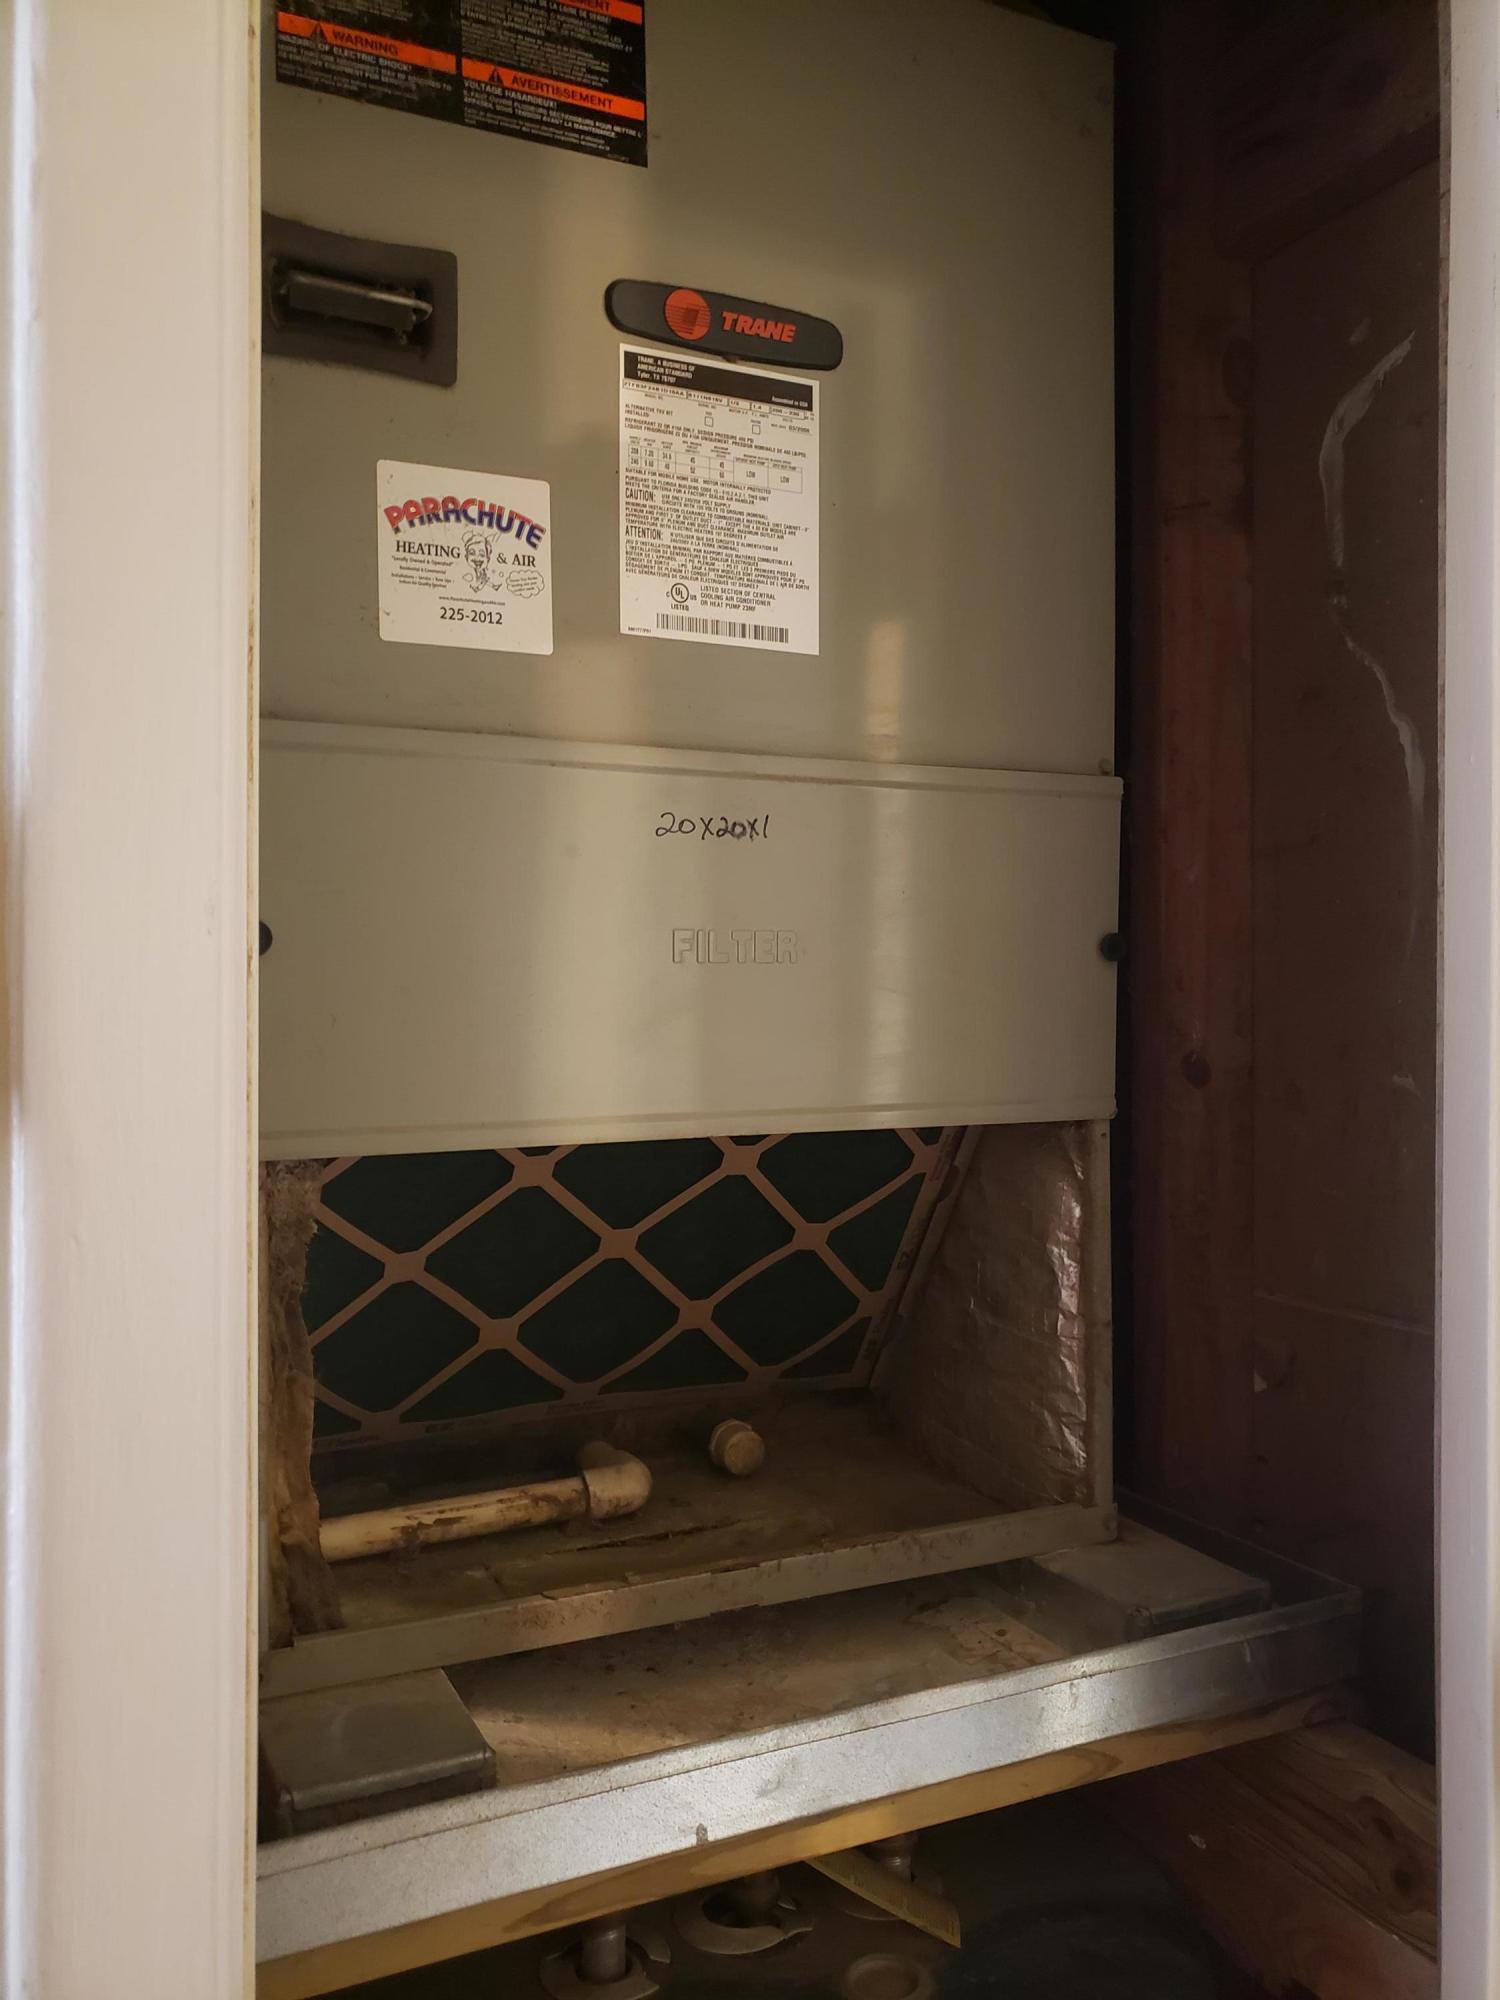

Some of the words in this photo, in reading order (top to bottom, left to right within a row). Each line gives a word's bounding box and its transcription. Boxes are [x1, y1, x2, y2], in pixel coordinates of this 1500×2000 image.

[332, 28, 397, 55] WARNING
[319, 42, 330, 52] OF
[333, 46, 376, 64] ELECTRIC
[464, 79, 502, 95] VOLTAGE
[511, 75, 613, 109] AVERTISSEMENT
[721, 312, 797, 342] TRANE
[637, 362, 663, 373] AMERICAN
[665, 368, 692, 378] STANDARD
[662, 359, 687, 370] BUSINESS
[688, 364, 696, 372] OF
[625, 416, 655, 426] REFRIGERANT
[714, 432, 736, 440] PRESSURE
[625, 467, 645, 475] SUITABLE
[719, 482, 745, 490] INTERNALLY
[747, 486, 771, 494] PROTECTED
[625, 475, 649, 483] PURSUANT
[678, 483, 698, 491] BUILDING
[746, 470, 755, 478] LOW
[780, 475, 789, 483] LOW
[625, 487, 655, 502] CAUTION:
[651, 484, 671, 492] CRITERIA
[734, 497, 754, 505] HANDLER
[661, 499, 681, 507] CIRCUITS
[625, 500, 647, 508] MINIMUM
[648, 504, 679, 513] INSTALLATION
[680, 509, 705, 517] CLEARANCE
[384, 496, 547, 550] PARACHUTE
[625, 518, 657, 527] TEMPERATURE
[625, 512, 649, 520] APPROVED
[737, 528, 758, 536] MAXIMUM
[625, 524, 663, 541] ATTENTION:
[396, 540, 460, 559] HEATING
[496, 553, 508, 564] &
[512, 554, 536, 567] AIR
[700, 585, 719, 593] LISTED
[721, 587, 743, 596] SECTION
[752, 591, 776, 600] CENTRAL
[700, 592, 723, 600] COOLING
[736, 596, 771, 606] CONDITIONER
[671, 603, 689, 611] LISTED
[725, 602, 740, 610] PUMP
[439, 607, 503, 625] 225-2012
[672, 928, 799, 964] FILTER
